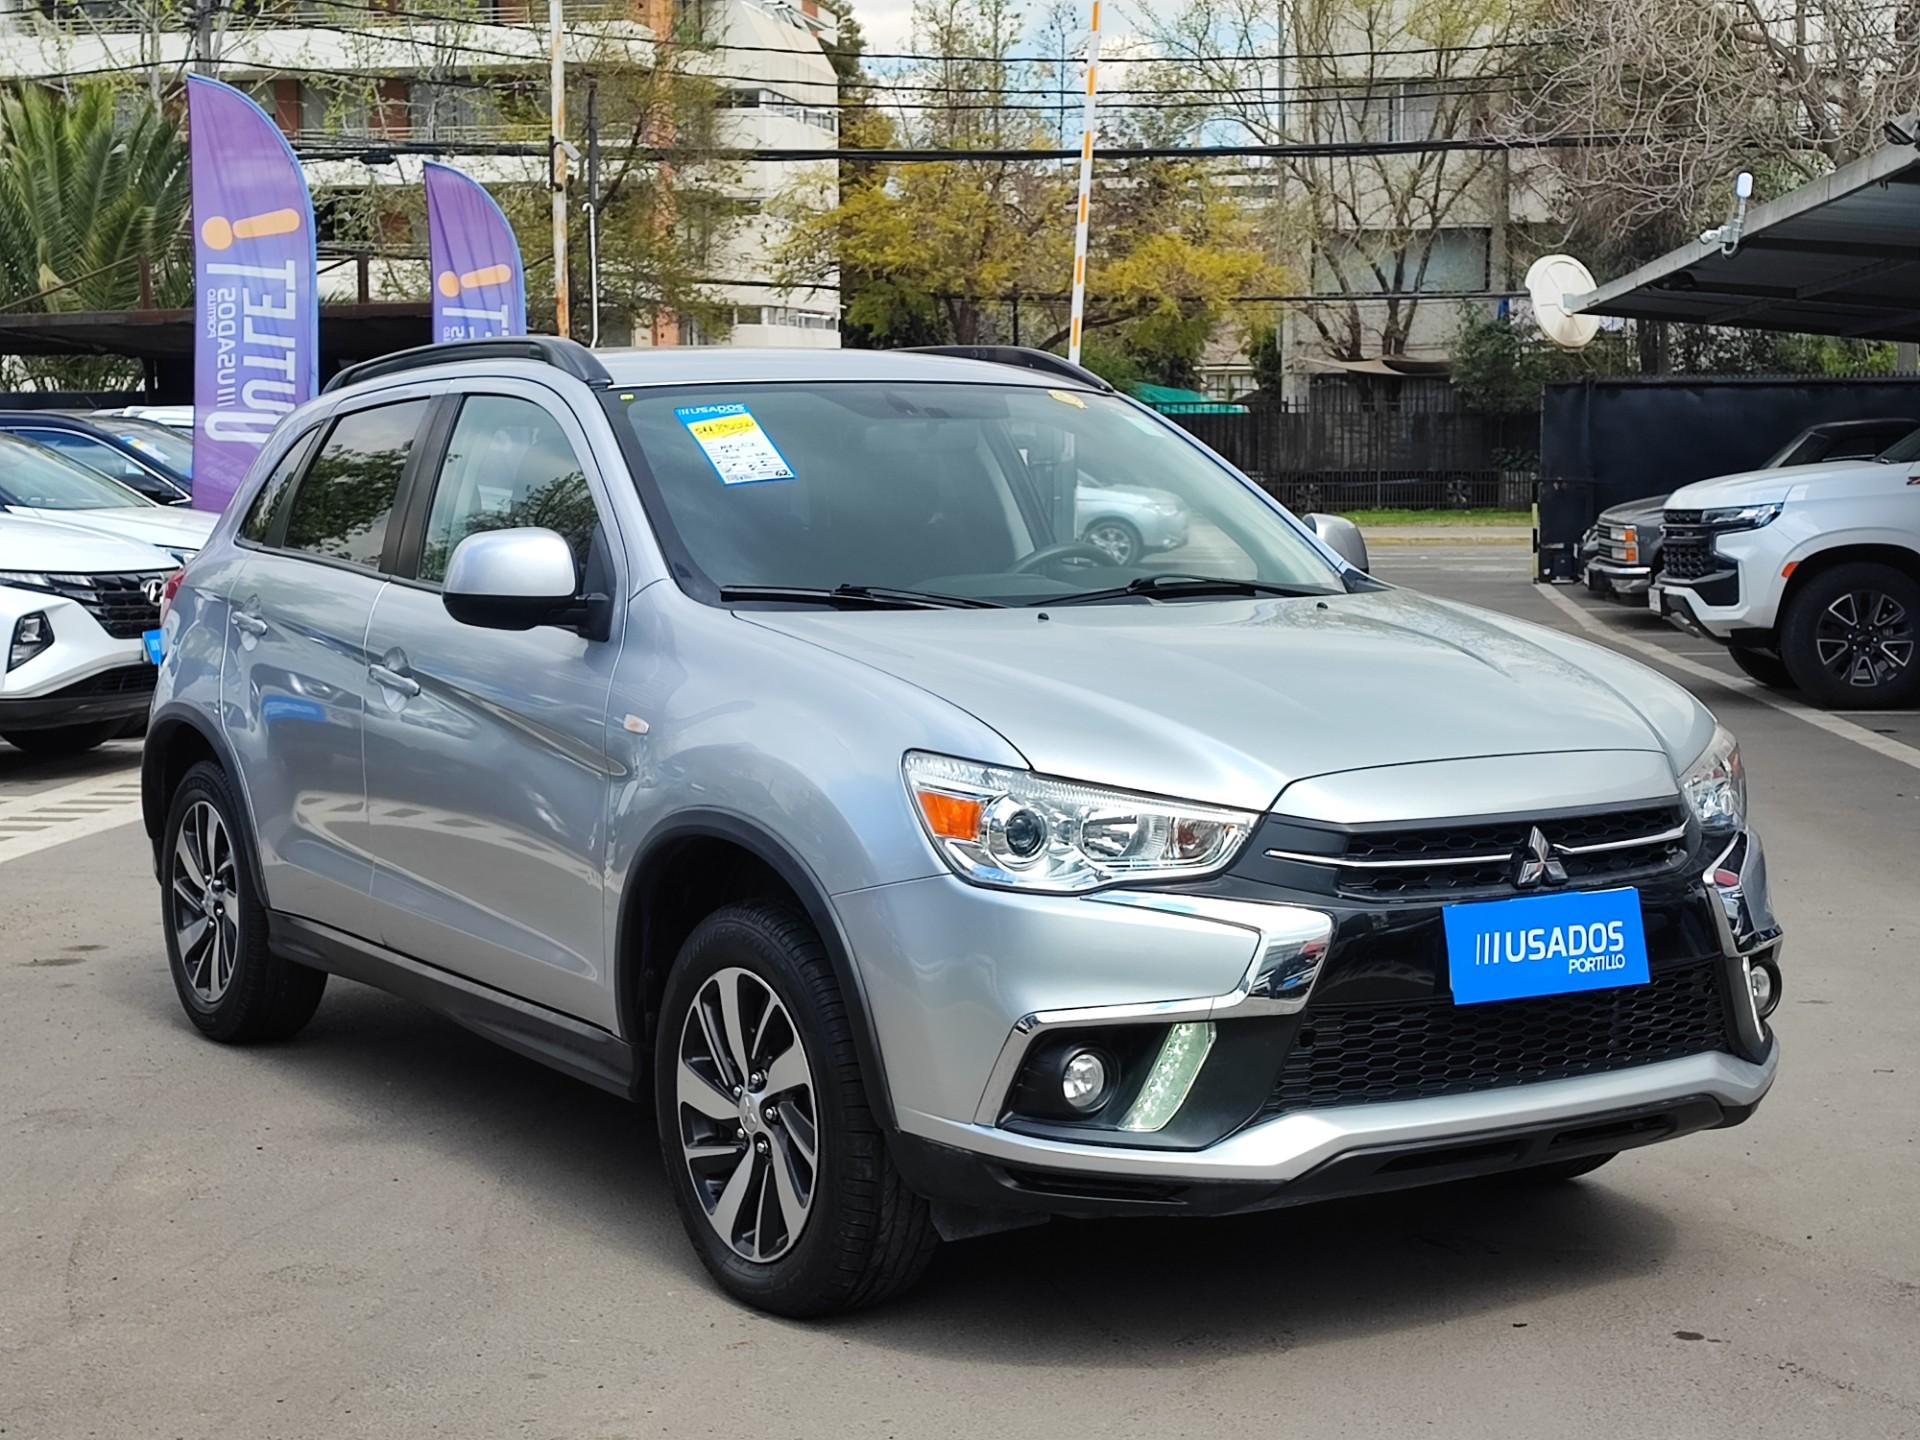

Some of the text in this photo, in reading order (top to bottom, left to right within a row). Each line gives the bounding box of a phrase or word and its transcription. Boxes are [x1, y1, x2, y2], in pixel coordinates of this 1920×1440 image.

[690, 404, 745, 414] USADOS
[1505, 920, 1625, 963] USADOS
[1568, 953, 1626, 975] PORTILLO
